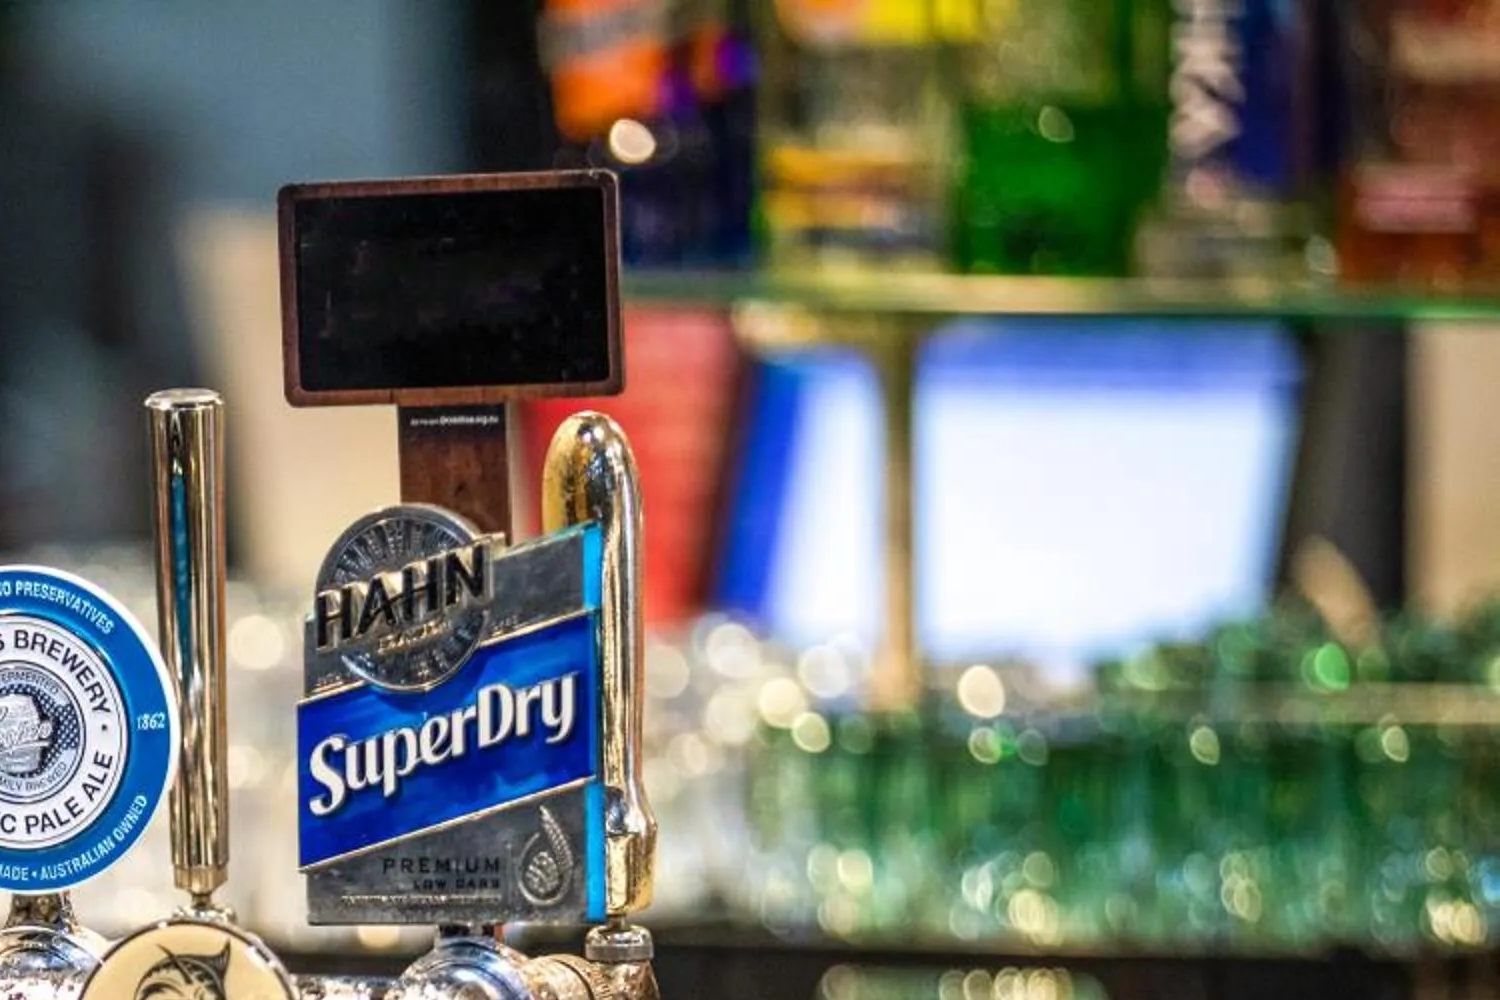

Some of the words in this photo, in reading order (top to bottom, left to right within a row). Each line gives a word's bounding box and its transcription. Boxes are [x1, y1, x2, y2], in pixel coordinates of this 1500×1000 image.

[16, 580, 116, 634] PRESERVATIVES
[316, 541, 489, 650] HAHN
[13, 628, 112, 717] BREWERY
[136, 711, 166, 731] 1862
[309, 672, 579, 817] SuperDry
[25, 796, 85, 835] PALE
[81, 751, 114, 802] ALE
[39, 838, 115, 881] AUSTRALIAN
[114, 795, 147, 842] OWNED
[382, 856, 500, 874] PREMIUM
[412, 878, 447, 890] LOW
